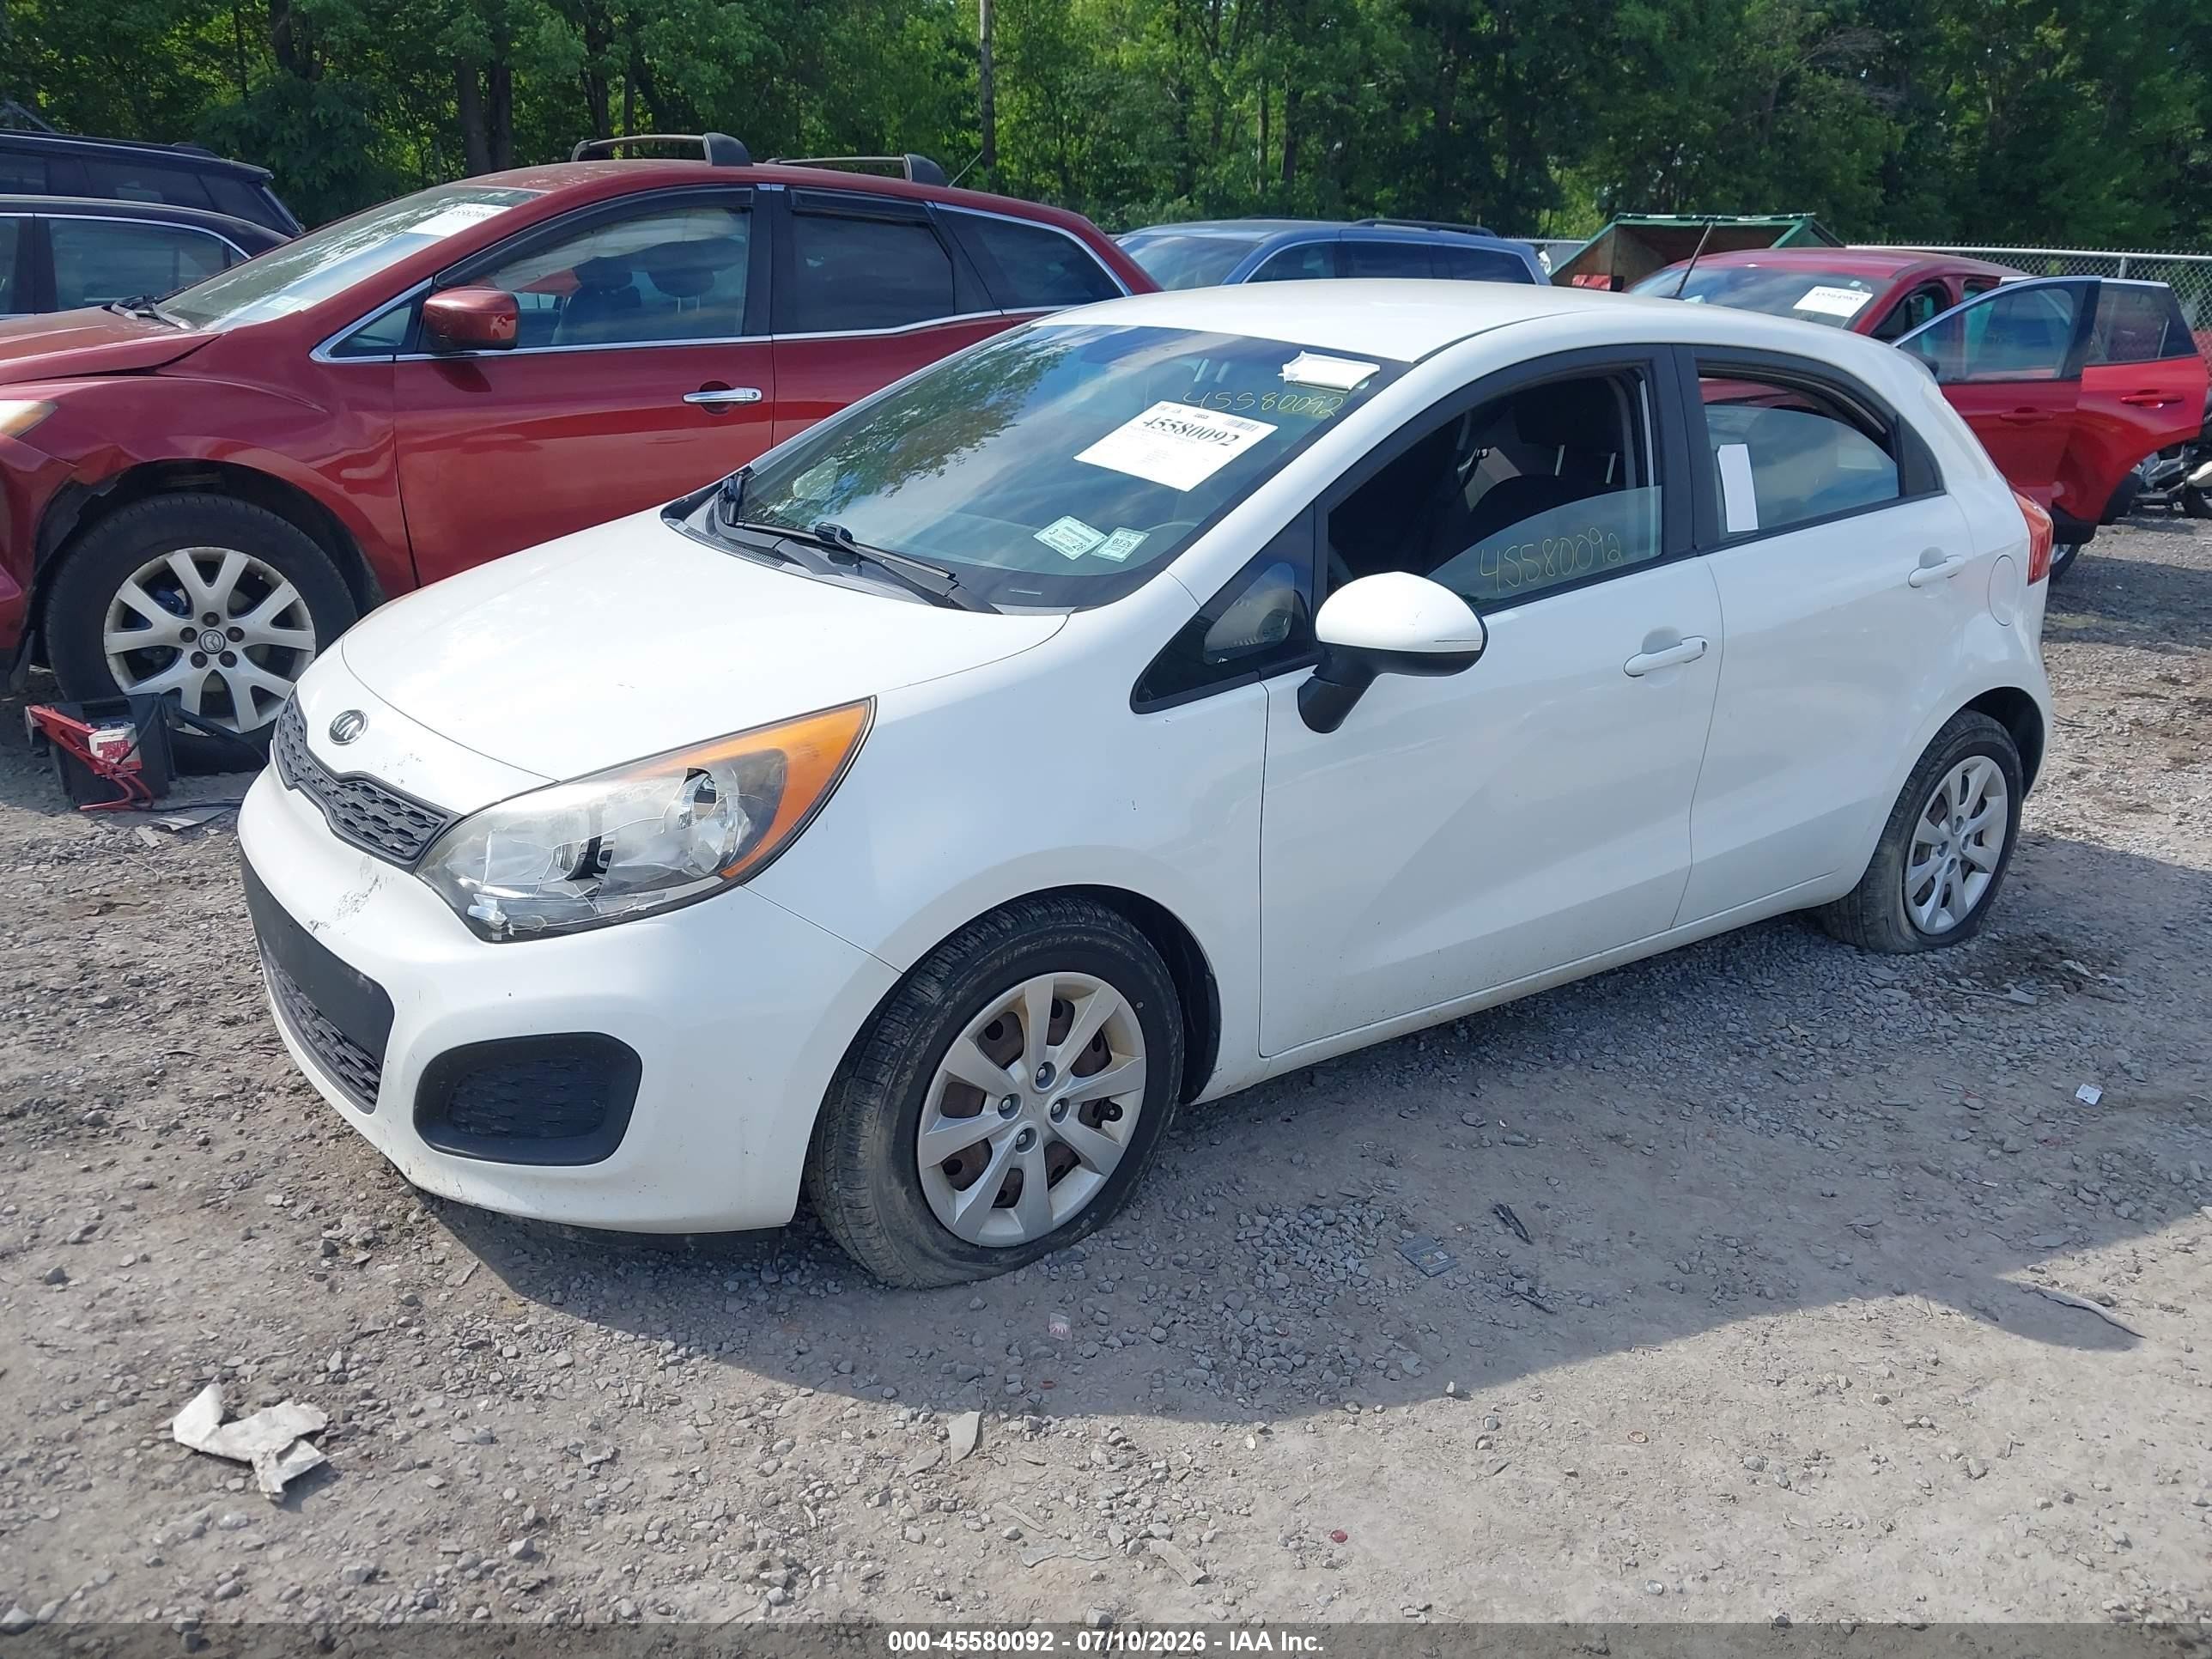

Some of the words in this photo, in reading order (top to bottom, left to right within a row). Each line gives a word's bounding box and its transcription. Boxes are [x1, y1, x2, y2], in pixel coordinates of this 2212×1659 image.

[1182, 391, 1344, 417] 45580092
[1143, 416, 1240, 447] 45580092
[1479, 527, 1624, 592] 45580092
